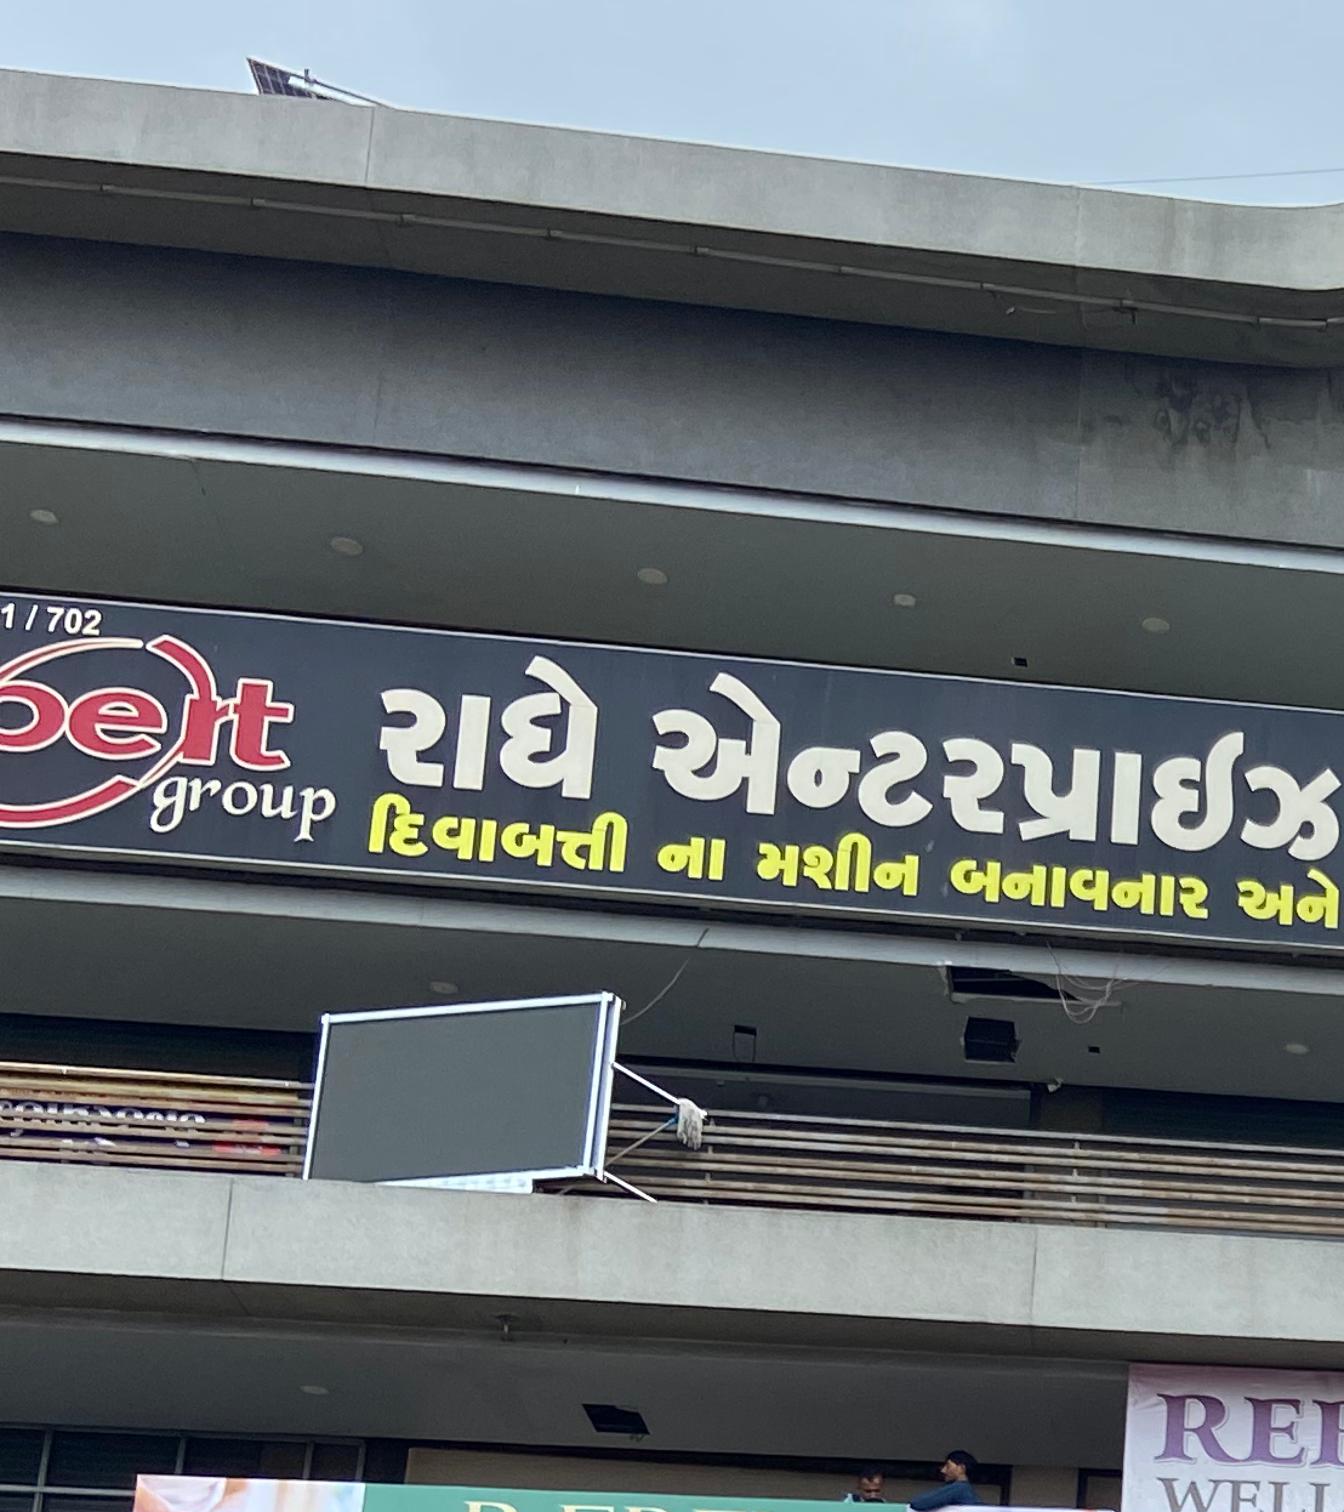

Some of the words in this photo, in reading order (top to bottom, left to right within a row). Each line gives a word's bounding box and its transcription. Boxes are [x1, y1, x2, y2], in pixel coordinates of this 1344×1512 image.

[46, 606, 103, 636] 702
[378, 655, 598, 800] રાધે
[650, 671, 1342, 862] એન્ટરપ્રાઈઝ
[150, 774, 337, 842] group
[656, 837, 727, 881] ના
[756, 830, 919, 896] મશીન
[949, 856, 1209, 921] બનાવનાર
[1237, 868, 1340, 930] અને
